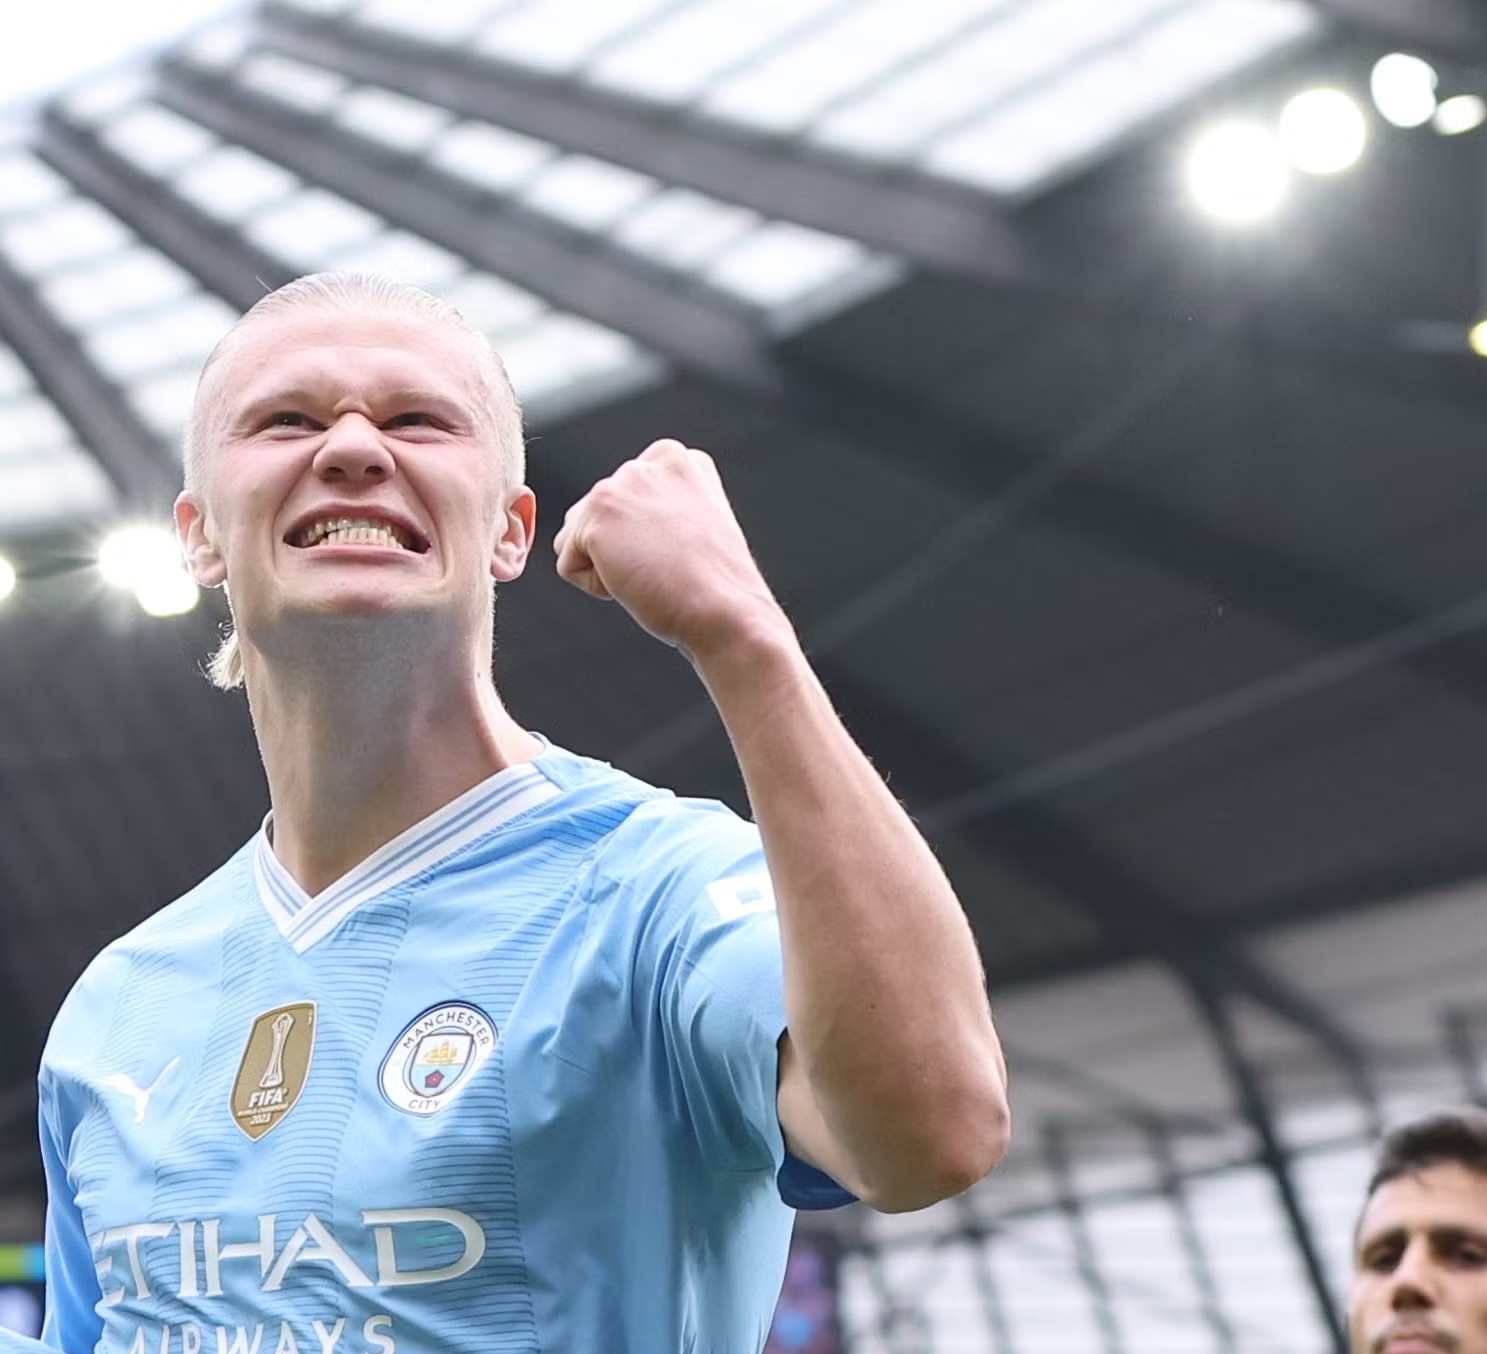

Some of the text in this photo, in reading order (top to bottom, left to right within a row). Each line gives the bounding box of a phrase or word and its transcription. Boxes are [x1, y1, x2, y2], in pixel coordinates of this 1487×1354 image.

[403, 1011, 490, 1049] MANCHESTER
[248, 1087, 284, 1108] FIFA
[408, 1100, 440, 1110] CITY
[89, 1207, 486, 1306] ETIHAD
